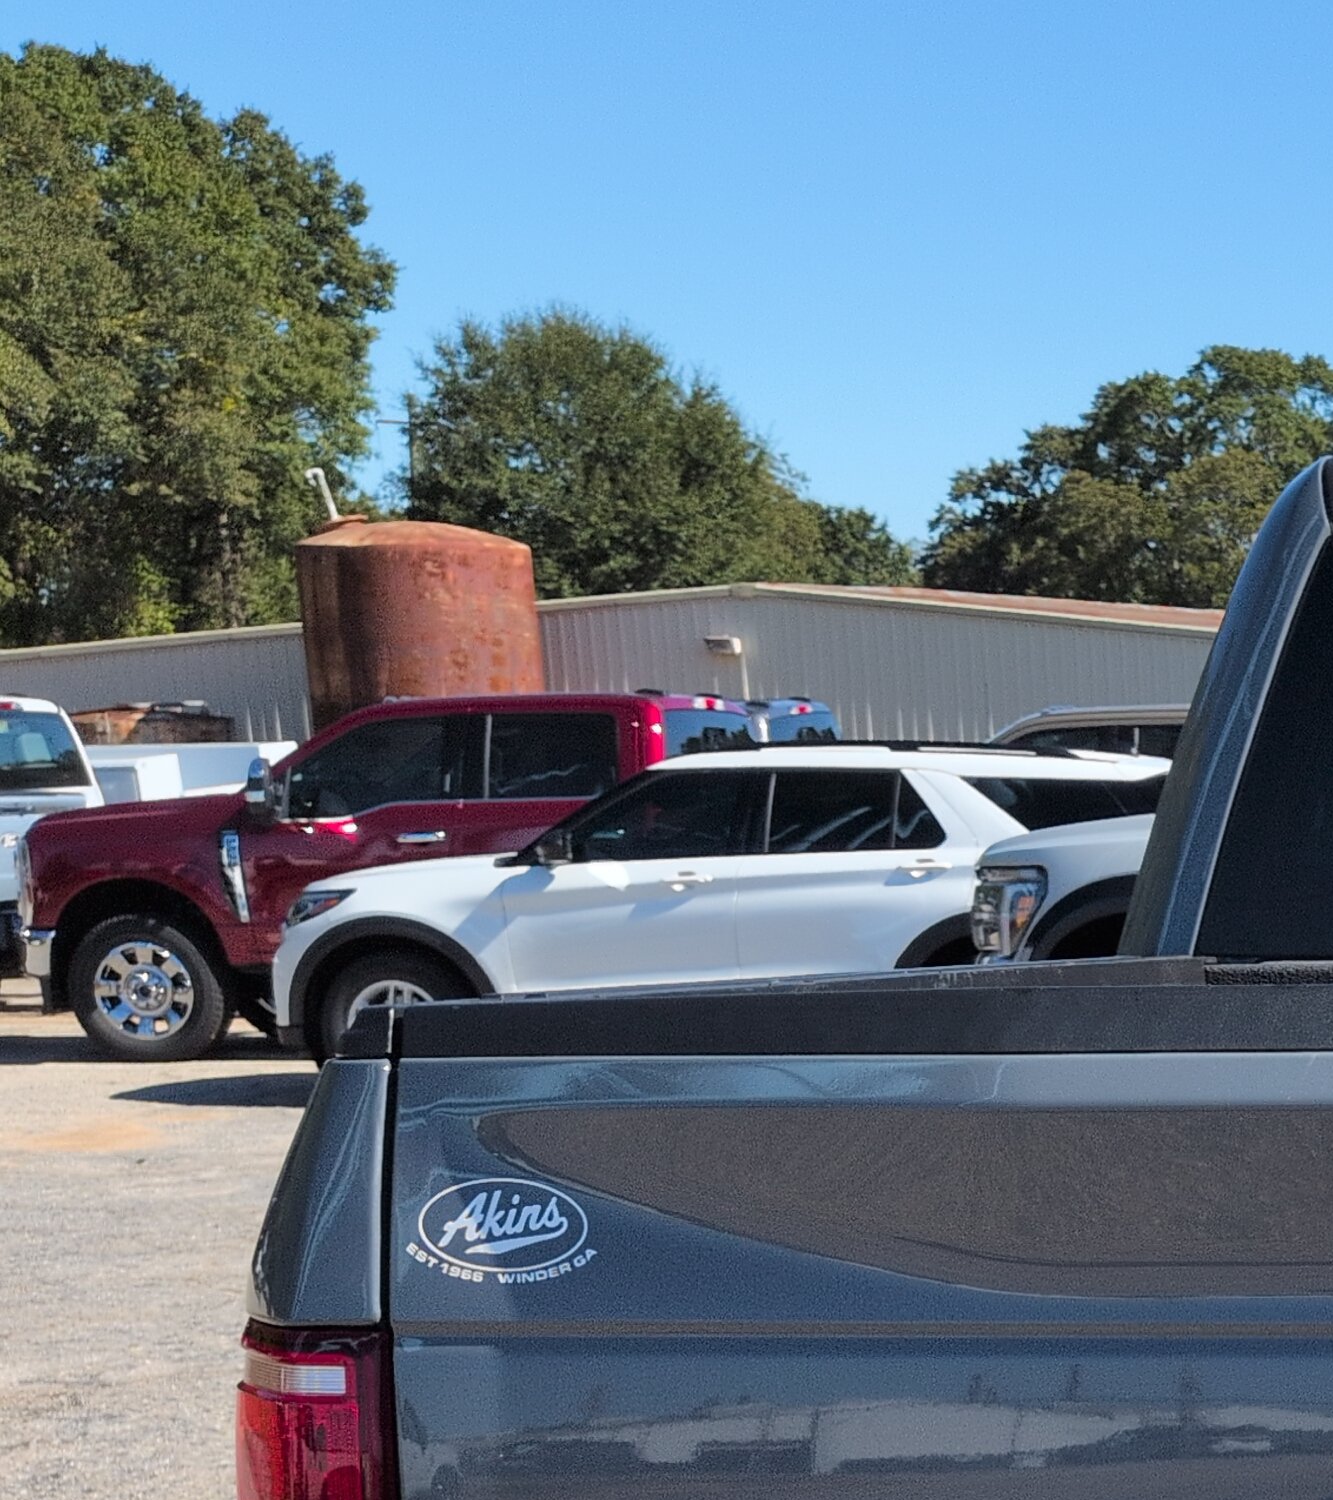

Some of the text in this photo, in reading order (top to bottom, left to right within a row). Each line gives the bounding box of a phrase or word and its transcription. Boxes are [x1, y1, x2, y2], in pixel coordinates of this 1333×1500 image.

[437, 1189, 568, 1254] Akins
[405, 1242, 439, 1269] EST
[497, 1264, 572, 1284] WINDER
[573, 1248, 599, 1267] GA
